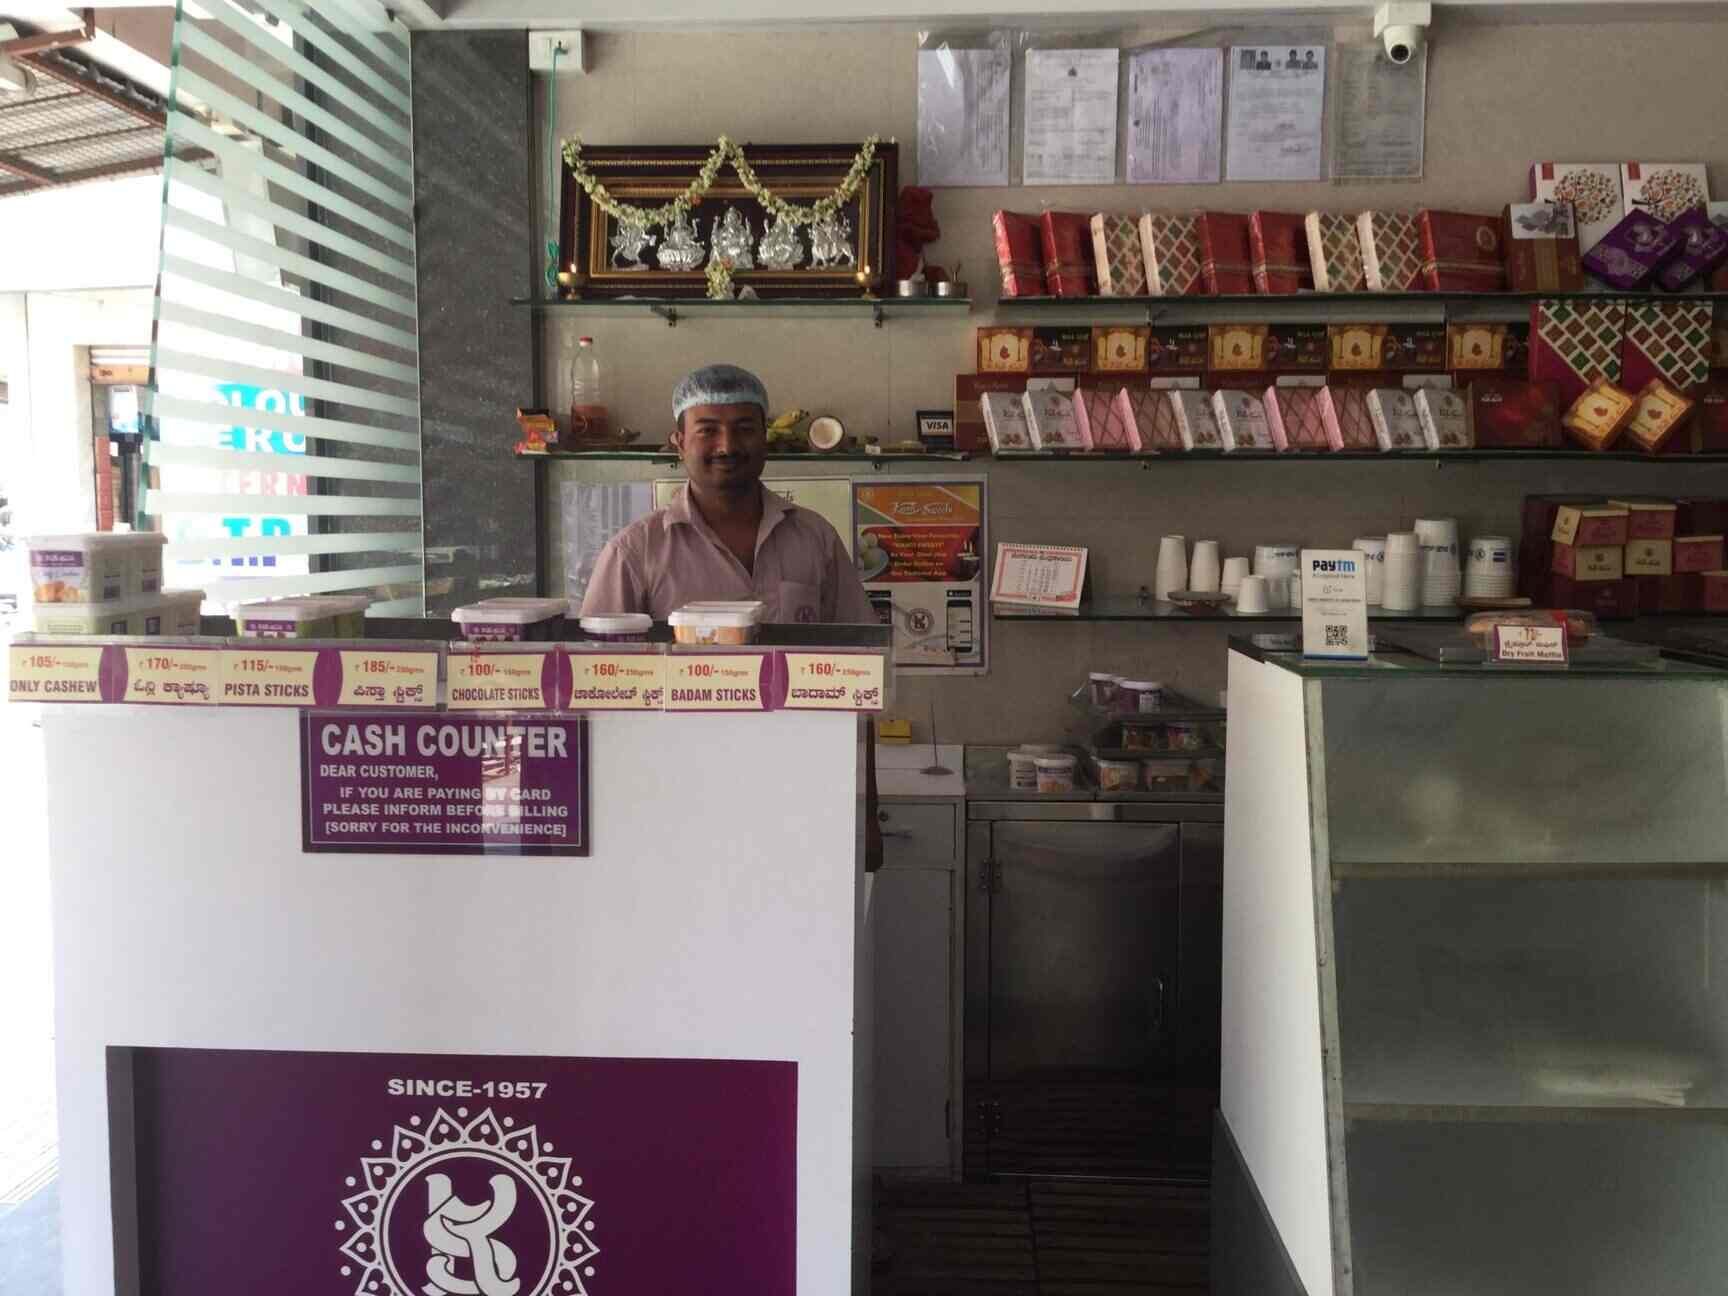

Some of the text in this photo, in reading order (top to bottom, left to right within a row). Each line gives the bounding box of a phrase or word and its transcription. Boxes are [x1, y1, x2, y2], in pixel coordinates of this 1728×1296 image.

[926, 420, 949, 431] VISA
[146, 656, 179, 671] 170/-
[241, 658, 274, 672] 115/-
[362, 659, 396, 673] 185/-
[469, 663, 501, 676] 100/-
[592, 663, 625, 677] 160/-
[687, 663, 719, 678] 100/-
[807, 662, 842, 677] 160/-
[9, 679, 98, 693] ONLY CASHEW
[224, 682, 310, 697] PISTA STICKS
[451, 688, 541, 701] CHOCOLATE STICKS
[671, 688, 757, 702] BADAM STICKS
[320, 723, 568, 757] CASH COUNTER
[319, 764, 439, 781] DEAR CUSTOMER,
[339, 787, 354, 799] IF
[358, 787, 390, 799] YOU
[394, 787, 424, 799] ARE
[427, 787, 482, 800] PAYING
[510, 787, 551, 801] CARD
[322, 803, 381, 816] PLEASE
[383, 804, 442, 816] INFORM
[325, 821, 568, 837] [SORRY FOR THE INCONVENIENCE]
[386, 1078, 548, 1099] SINCE-1957
